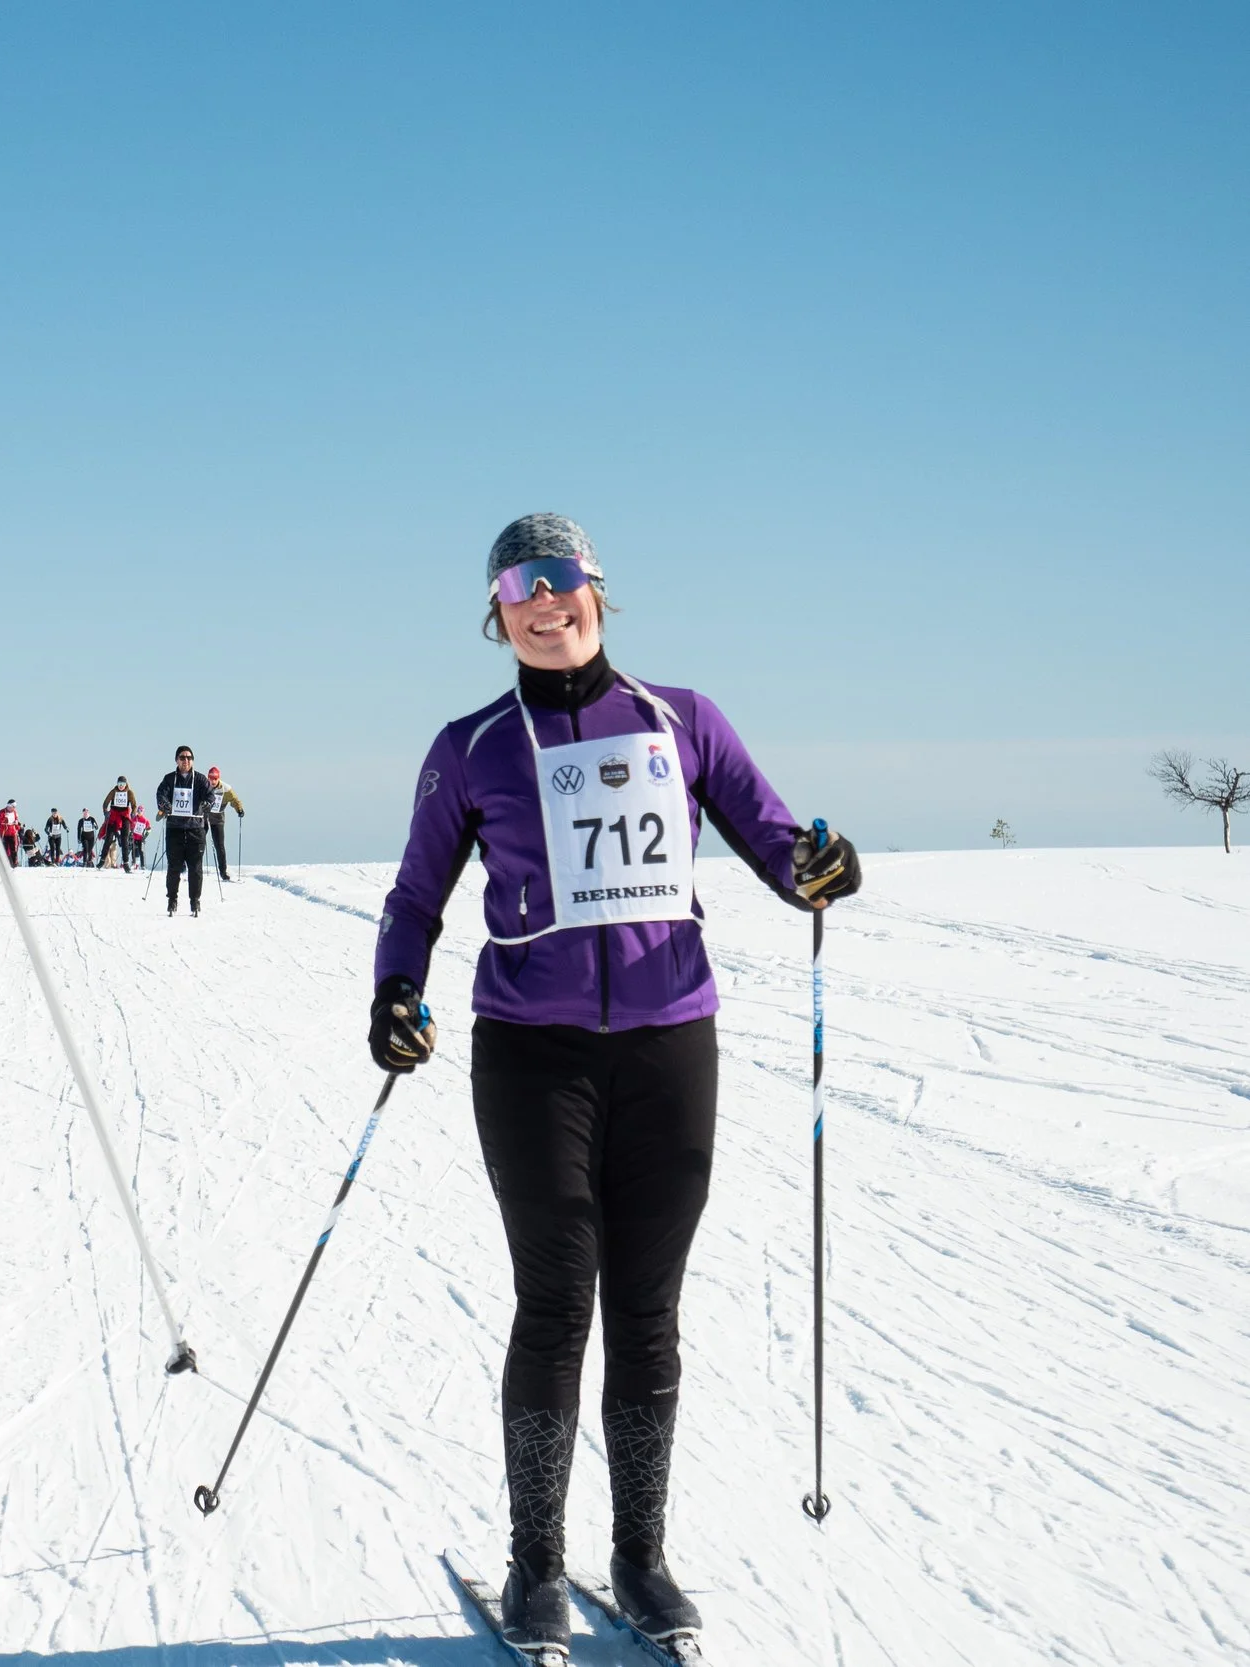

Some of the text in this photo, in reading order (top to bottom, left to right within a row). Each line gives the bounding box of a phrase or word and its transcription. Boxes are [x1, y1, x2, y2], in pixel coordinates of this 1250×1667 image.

[175, 799, 190, 808] 707
[572, 812, 668, 869] 712
[571, 884, 679, 904] BERNERS
